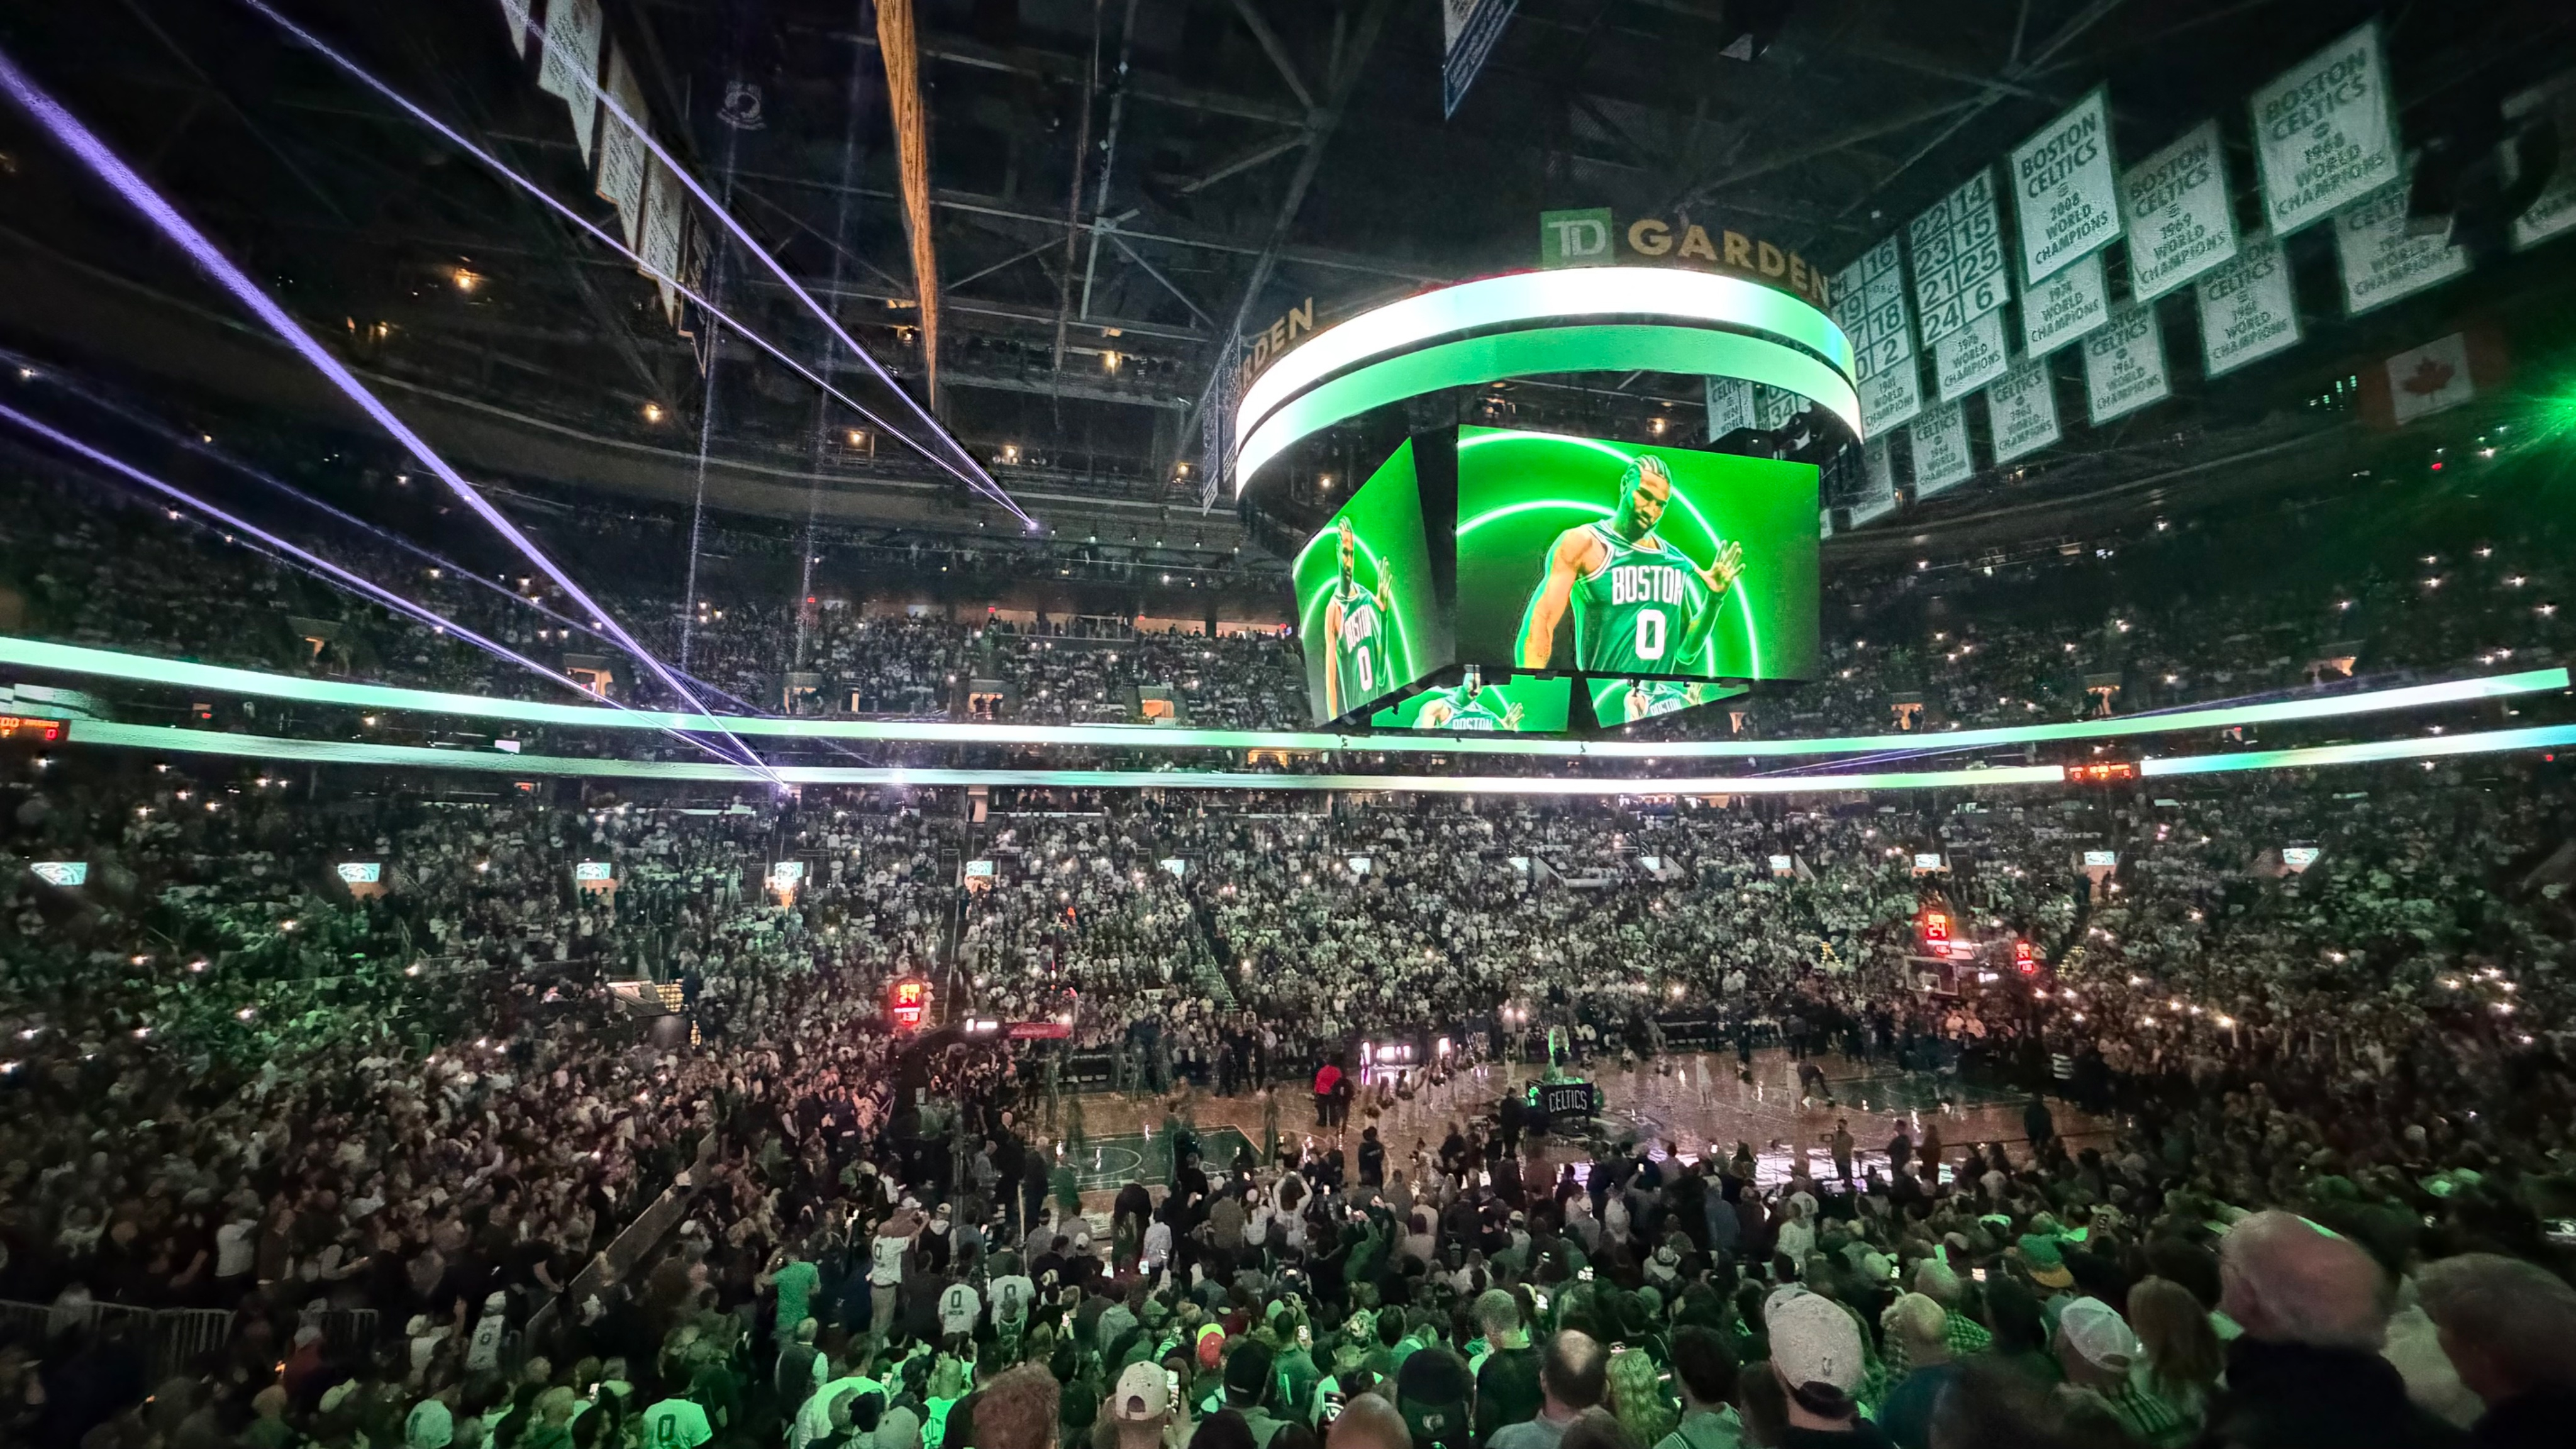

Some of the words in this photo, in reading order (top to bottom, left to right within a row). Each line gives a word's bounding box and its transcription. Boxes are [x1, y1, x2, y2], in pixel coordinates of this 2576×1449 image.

[2267, 47, 2367, 123] BOSTON
[2272, 74, 2366, 140] CELTICS
[2021, 113, 2096, 179] BOSTON
[2028, 138, 2097, 198] CELTICS
[2130, 139, 2208, 200] BOSTON
[1956, 177, 1984, 214] 14
[2050, 192, 2079, 221] 2008
[2136, 162, 2209, 218] CELTICS
[1913, 205, 1947, 245] 22
[1958, 208, 1990, 246] 15
[2036, 211, 2107, 265] CHAMPIONS
[2046, 204, 2091, 240] WORLD
[1867, 242, 1894, 273] 16
[1918, 238, 1950, 276] 23
[2141, 231, 2226, 284] CHAMPIONS
[2153, 225, 2205, 260] WORLD
[1548, 219, 1606, 256] TD
[1628, 218, 1829, 308] GARDEN
[1962, 240, 1997, 285] 25
[2209, 257, 2274, 301] CELTICS
[1922, 269, 1954, 309] 21
[1975, 282, 1993, 311] 6
[2041, 292, 2083, 321] WORLD
[1837, 296, 1860, 326] 19
[1872, 303, 1900, 336] 18
[1924, 302, 1959, 341] 24
[2032, 299, 2099, 341] CHAMPIONS
[1243, 297, 1313, 389] RDEN
[1884, 338, 1898, 365] 2
[1953, 343, 1987, 368] WORLD
[2092, 318, 2148, 357] CELTICS
[1944, 351, 2001, 387] CHAMPIONS
[1995, 370, 2041, 403] CELTICS
[1771, 397, 1792, 426] 34
[1918, 412, 1958, 440] CELTICS
[1611, 565, 1687, 606] BOSTON
[1345, 604, 1372, 653] BOSTON
[1636, 609, 1666, 659] 0
[1358, 646, 1373, 691] 0
[1928, 922, 1946, 937] 24
[899, 992, 916, 1004] 24
[1549, 1090, 1587, 1113] CELTICS
[875, 1243, 882, 1260] 0
[951, 1291, 962, 1308] 0
[657, 1414, 675, 1441] 0
